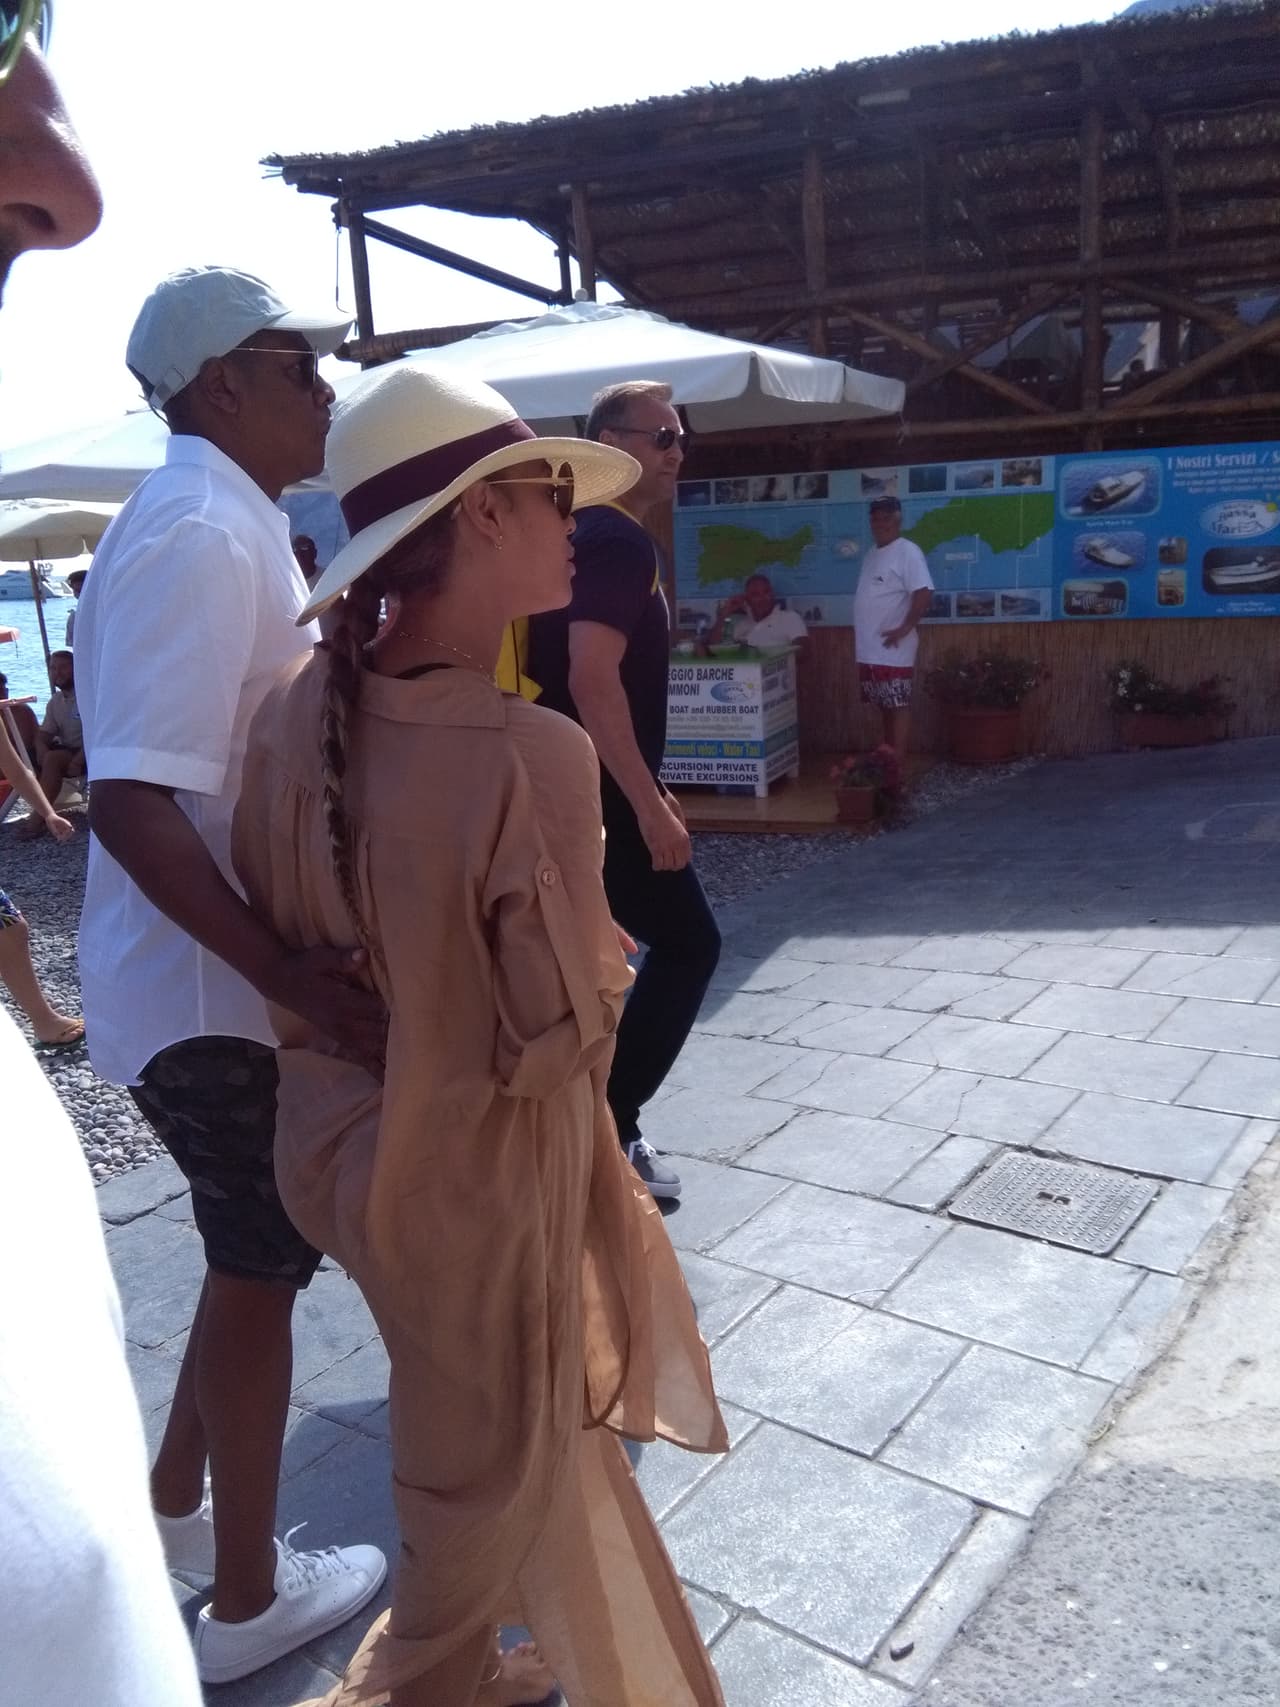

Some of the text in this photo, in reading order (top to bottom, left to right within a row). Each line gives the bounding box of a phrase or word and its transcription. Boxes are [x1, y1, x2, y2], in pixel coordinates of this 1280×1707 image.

[1176, 454, 1211, 469] Nostri
[1215, 451, 1256, 467] Servizi
[697, 668, 734, 681] BARCHE
[669, 705, 759, 714] BOAT and RUBBER BOAT
[660, 762, 757, 772] SCURSIONI PRIVATE
[696, 773, 759, 783] EXCURSIONS
